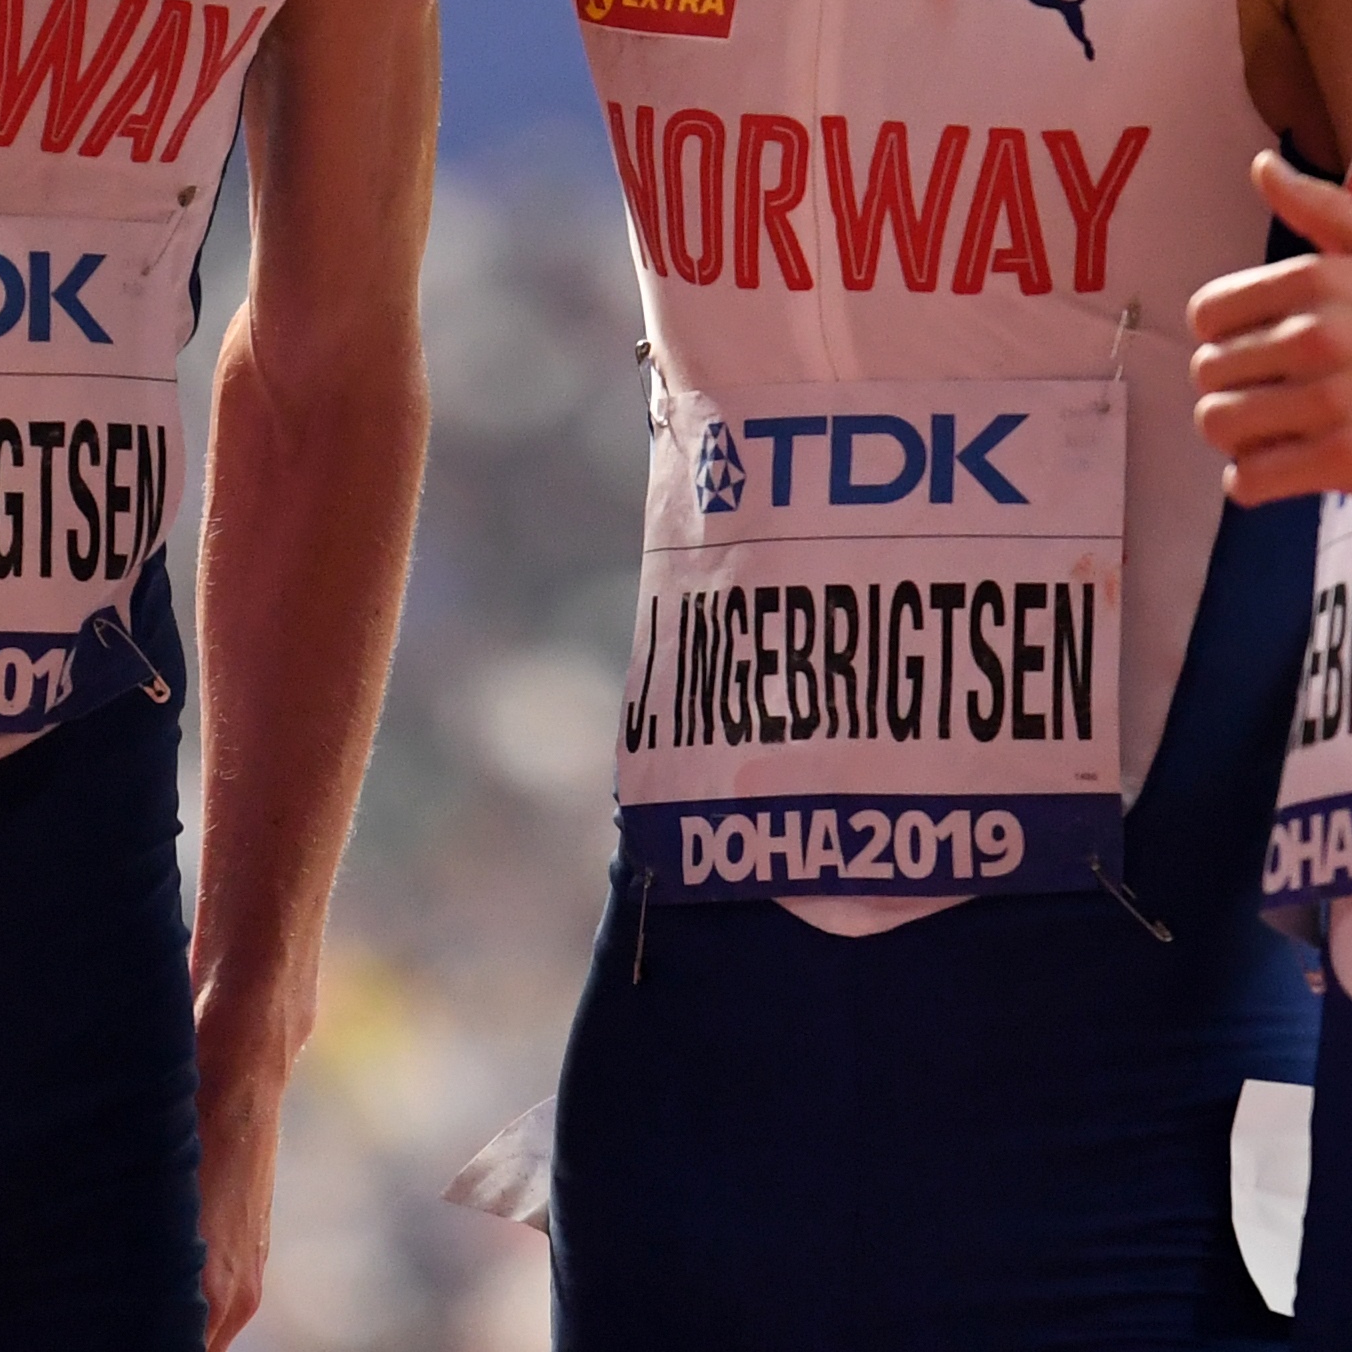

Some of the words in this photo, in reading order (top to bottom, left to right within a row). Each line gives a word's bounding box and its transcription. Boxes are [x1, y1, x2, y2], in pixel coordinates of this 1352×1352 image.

[607, 100, 1151, 296] NORWAY
[743, 413, 1031, 508] TDK
[624, 594, 658, 754] J.
[673, 579, 1096, 748] INGEBRIGTSEN
[679, 808, 1025, 886] DOHA2019
